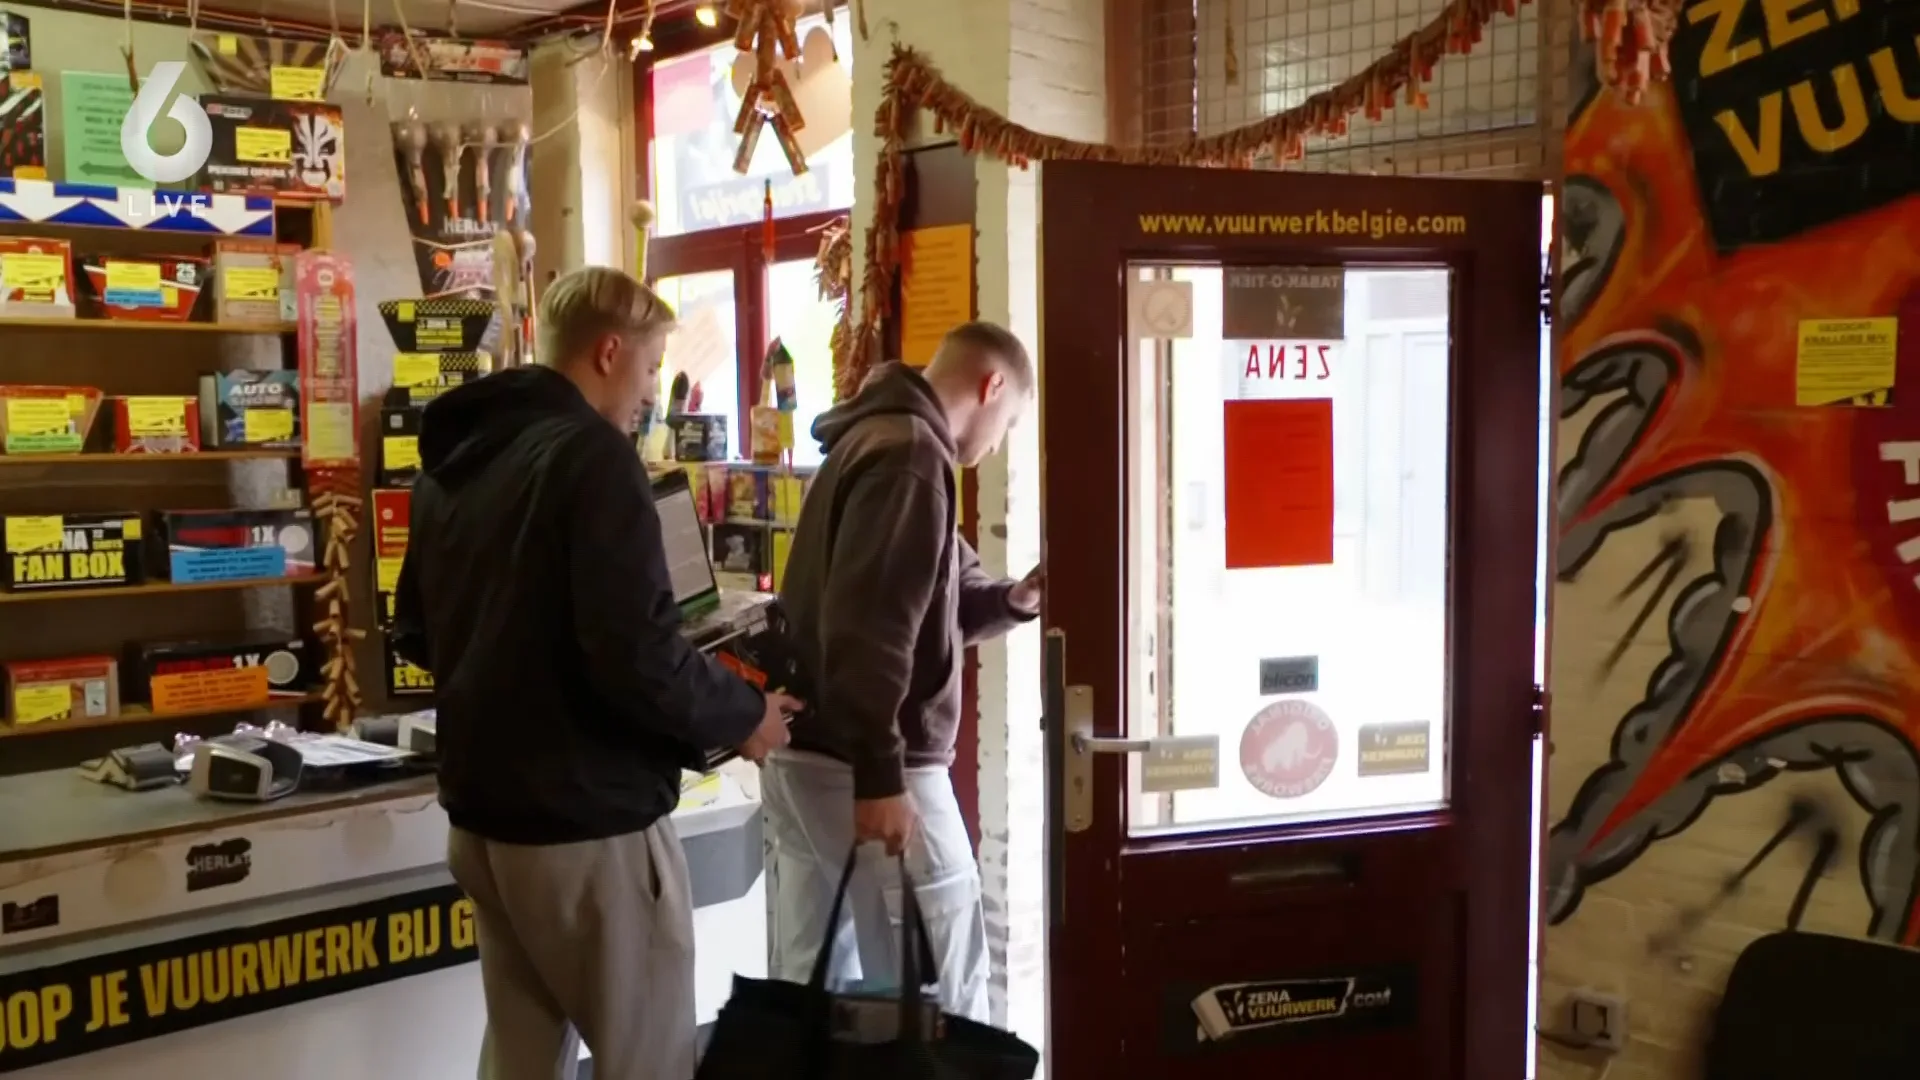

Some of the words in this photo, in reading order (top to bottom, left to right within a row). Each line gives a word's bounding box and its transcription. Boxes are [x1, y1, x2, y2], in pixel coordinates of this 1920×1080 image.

[1687, 0, 1860, 77] ZE
[1139, 209, 1467, 239] www.vuurwerkbelgie.com
[229, 383, 283, 396] AUTO
[13, 553, 64, 582] FAN
[69, 551, 126, 579] BOX
[85, 969, 130, 1033] JE
[140, 917, 379, 1019] VUURWERK
[387, 903, 441, 964] BIJ
[450, 896, 478, 950] G
[1247, 990, 1291, 1006] ZENA
[1247, 997, 1337, 1019] VUURWERK
